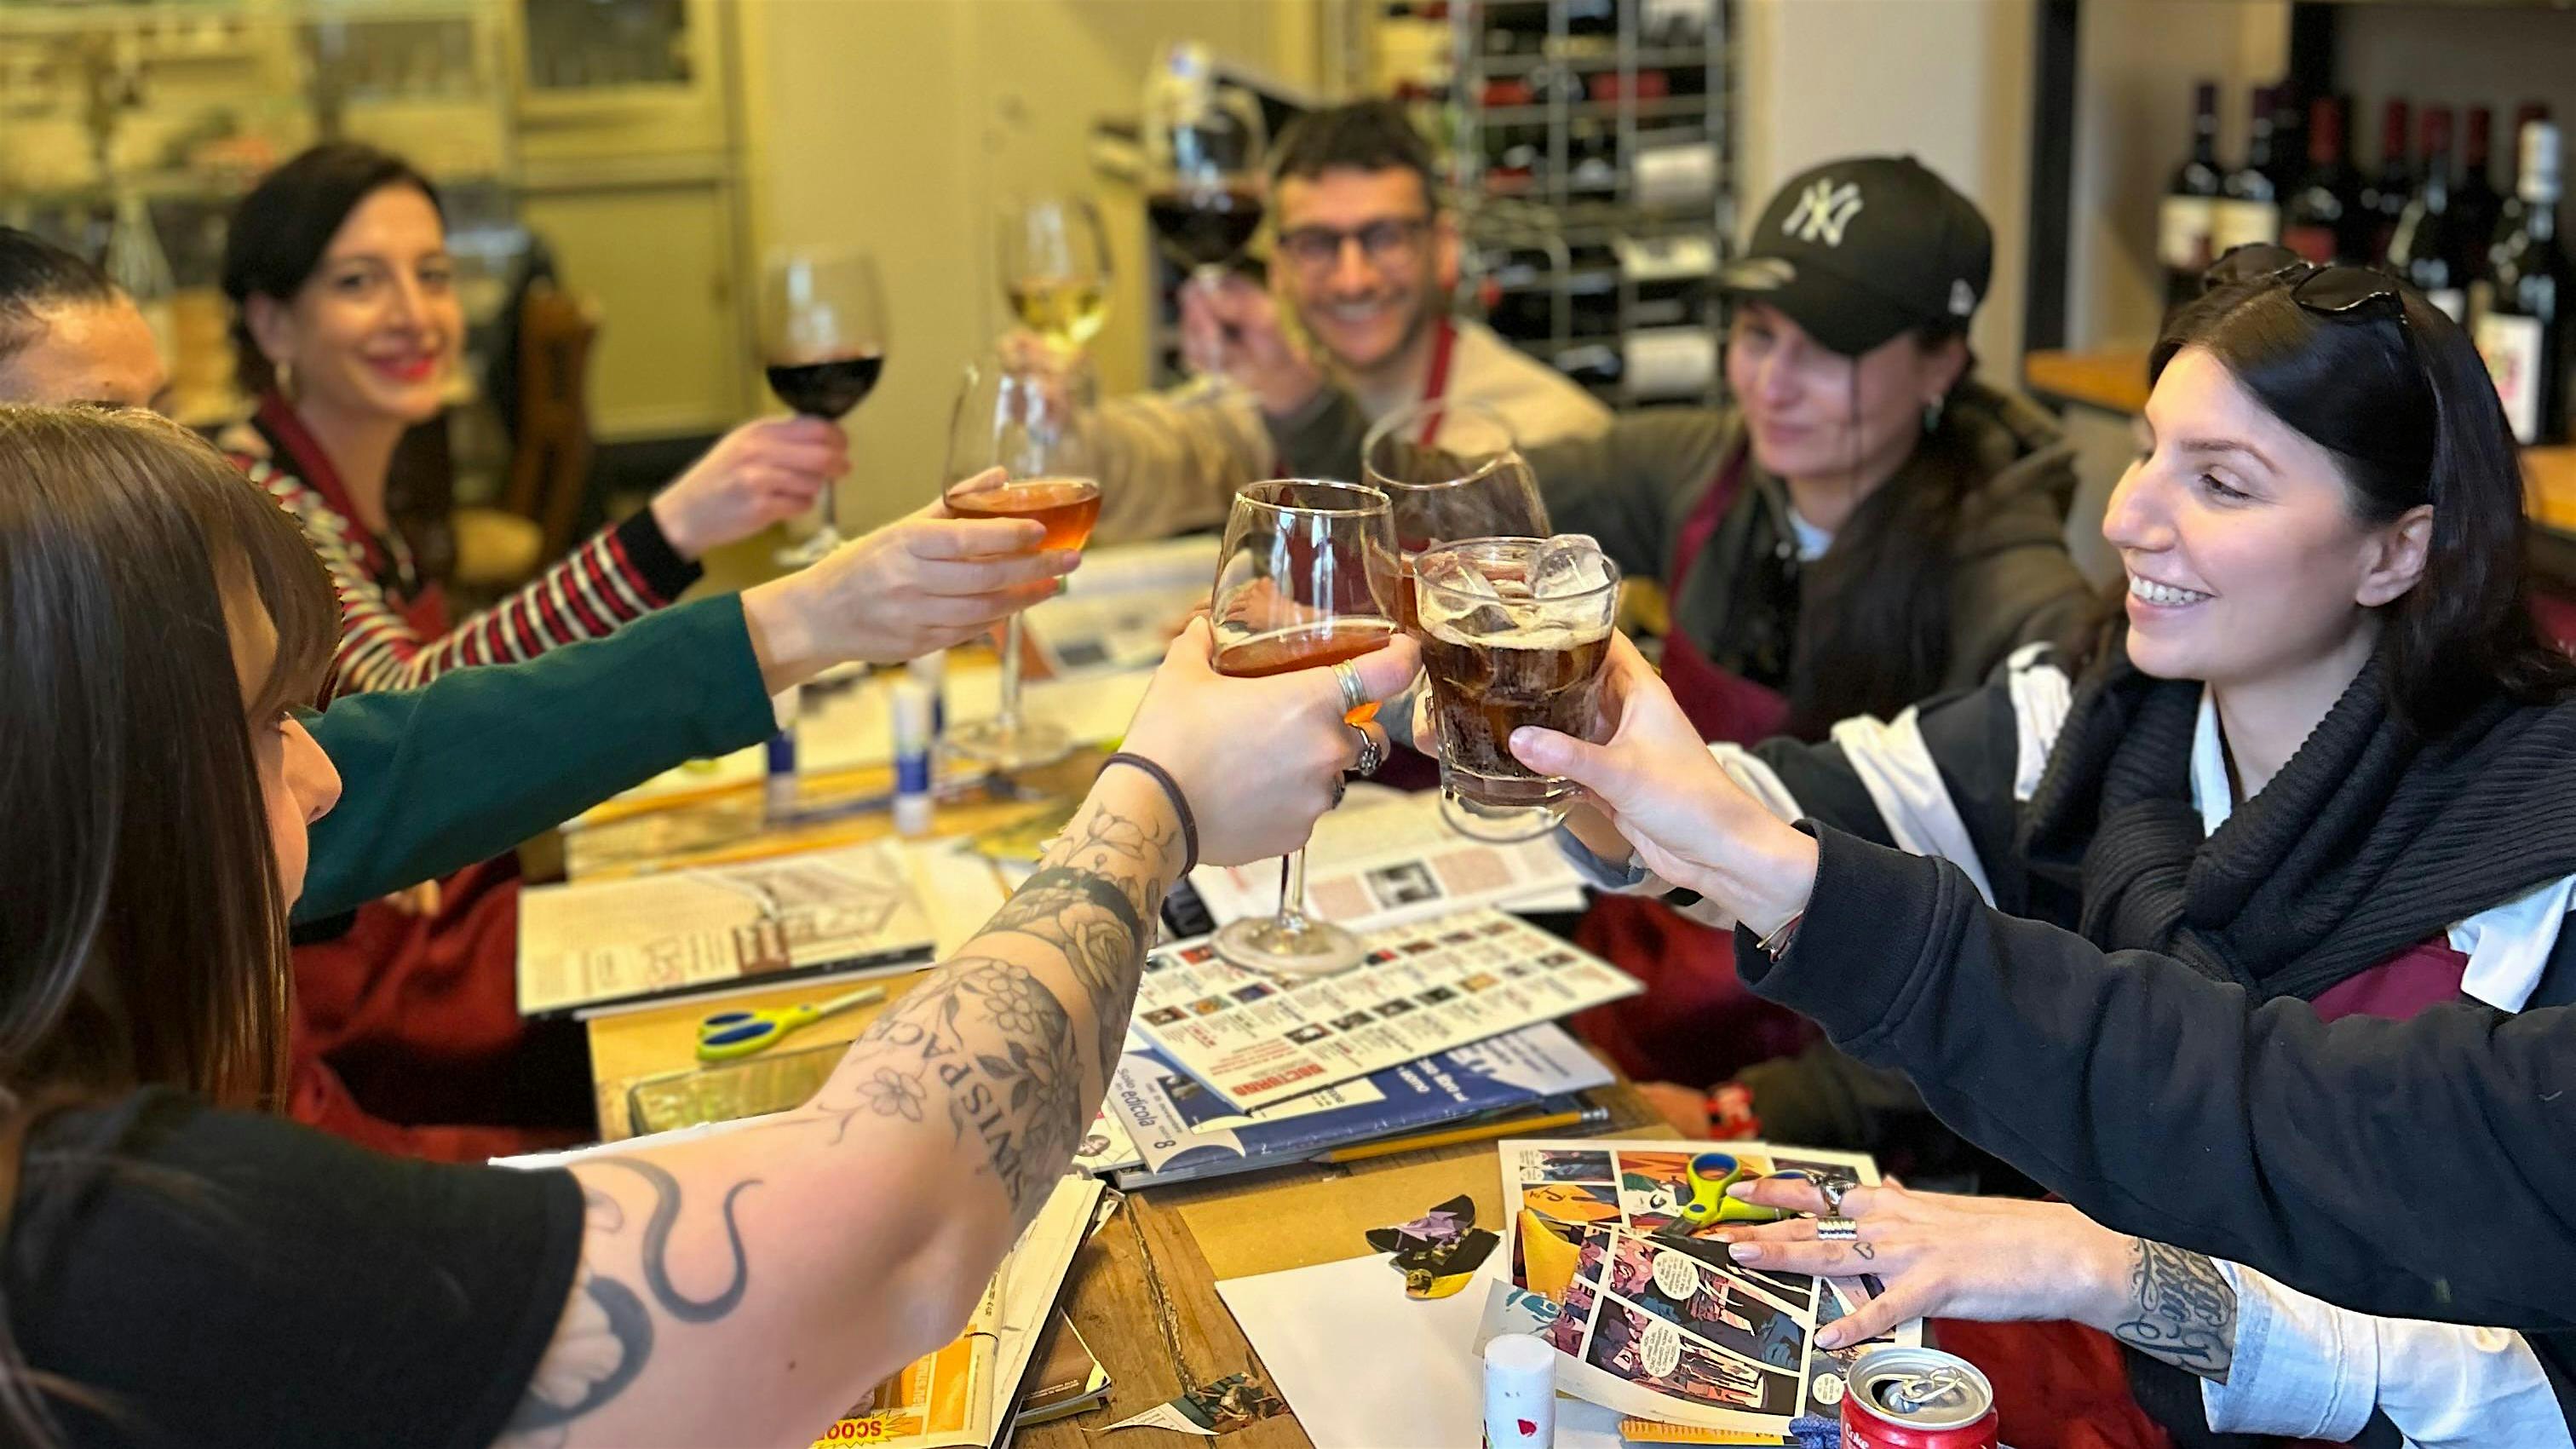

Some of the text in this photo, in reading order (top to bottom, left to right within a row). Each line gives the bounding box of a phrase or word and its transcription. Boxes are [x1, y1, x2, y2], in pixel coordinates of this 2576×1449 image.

[1781, 177, 1863, 247] NY
[1120, 1090, 1158, 1127] edicola
[1153, 1140, 1177, 1149] 8
[1845, 1423, 1870, 1449] Coke
